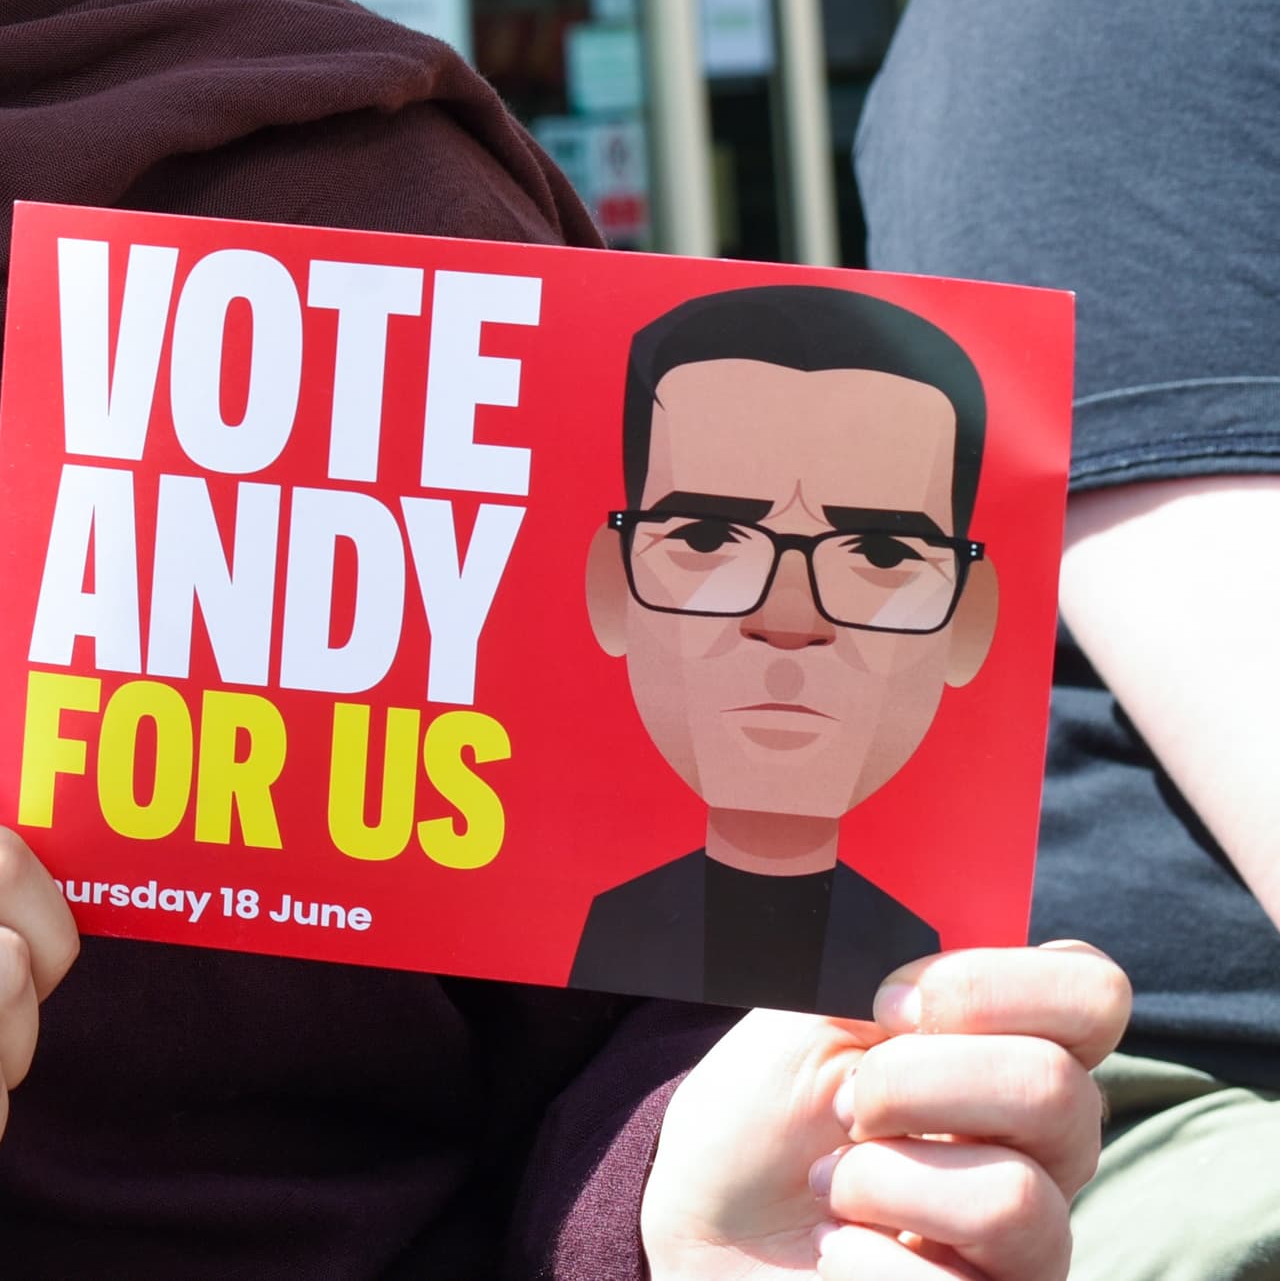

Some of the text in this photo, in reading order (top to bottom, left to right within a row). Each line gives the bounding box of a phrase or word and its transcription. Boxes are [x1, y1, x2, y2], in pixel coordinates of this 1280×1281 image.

[57, 238, 543, 496] VOTE
[27, 464, 527, 706] ANDY
[18, 670, 512, 870] FOR US
[219, 886, 261, 920] 18
[268, 894, 374, 932] June
